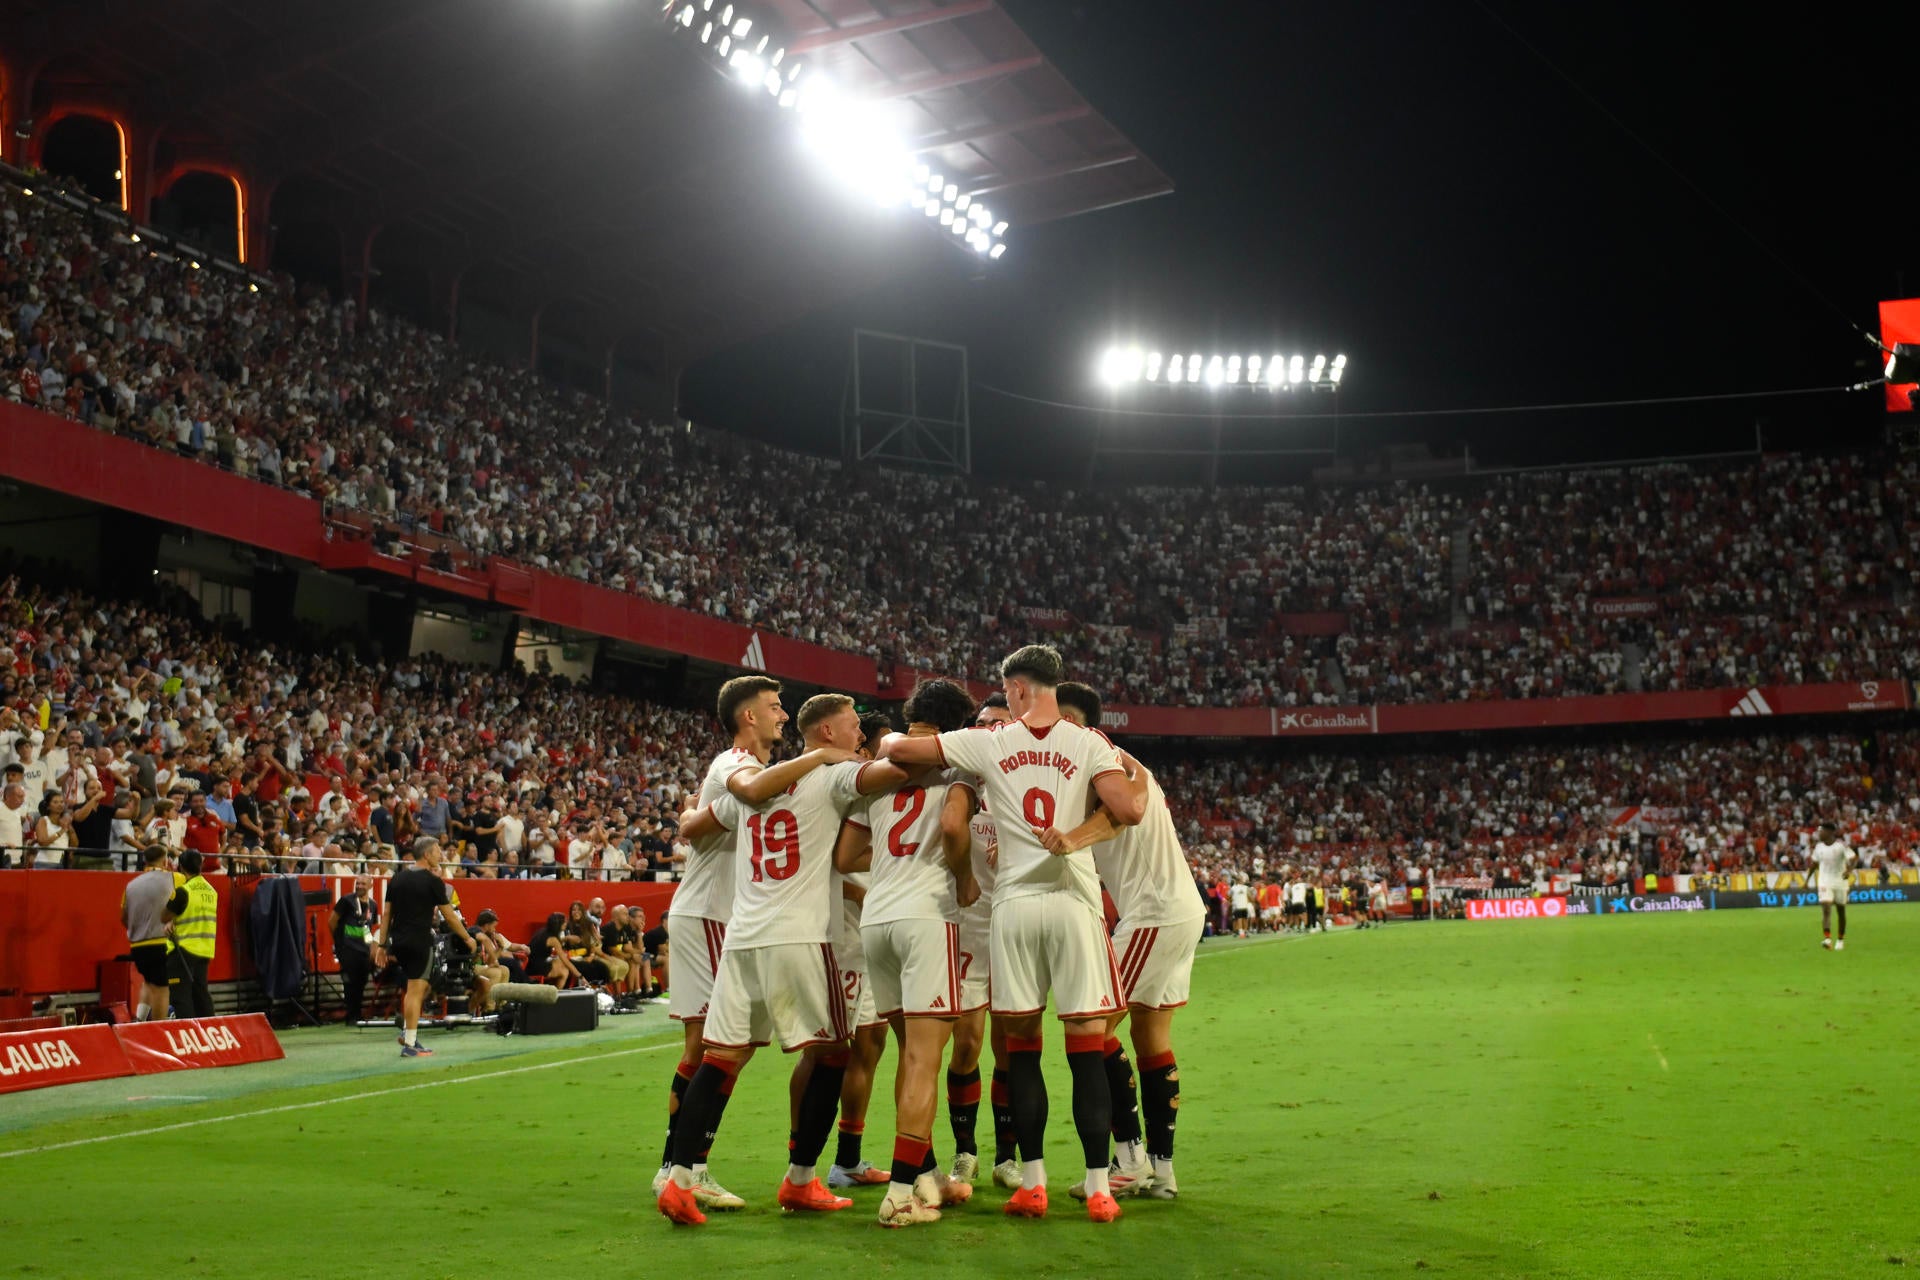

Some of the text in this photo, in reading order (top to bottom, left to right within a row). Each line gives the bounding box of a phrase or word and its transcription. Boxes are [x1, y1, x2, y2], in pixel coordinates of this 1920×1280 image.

[1100, 711, 1129, 729] mpo
[1300, 713, 1369, 728] CaixaBank
[999, 750, 1078, 780] ROBBIE URE
[888, 785, 926, 857] 2
[746, 808, 800, 882] 19
[1566, 900, 1589, 914] ank
[1630, 896, 1704, 912] CaixaBank
[1758, 891, 1778, 906] Tú
[1782, 894, 1792, 908] y
[1847, 888, 1907, 901] sotros.
[1470, 900, 1538, 918] LALIGA
[166, 1025, 241, 1056] LALIGA
